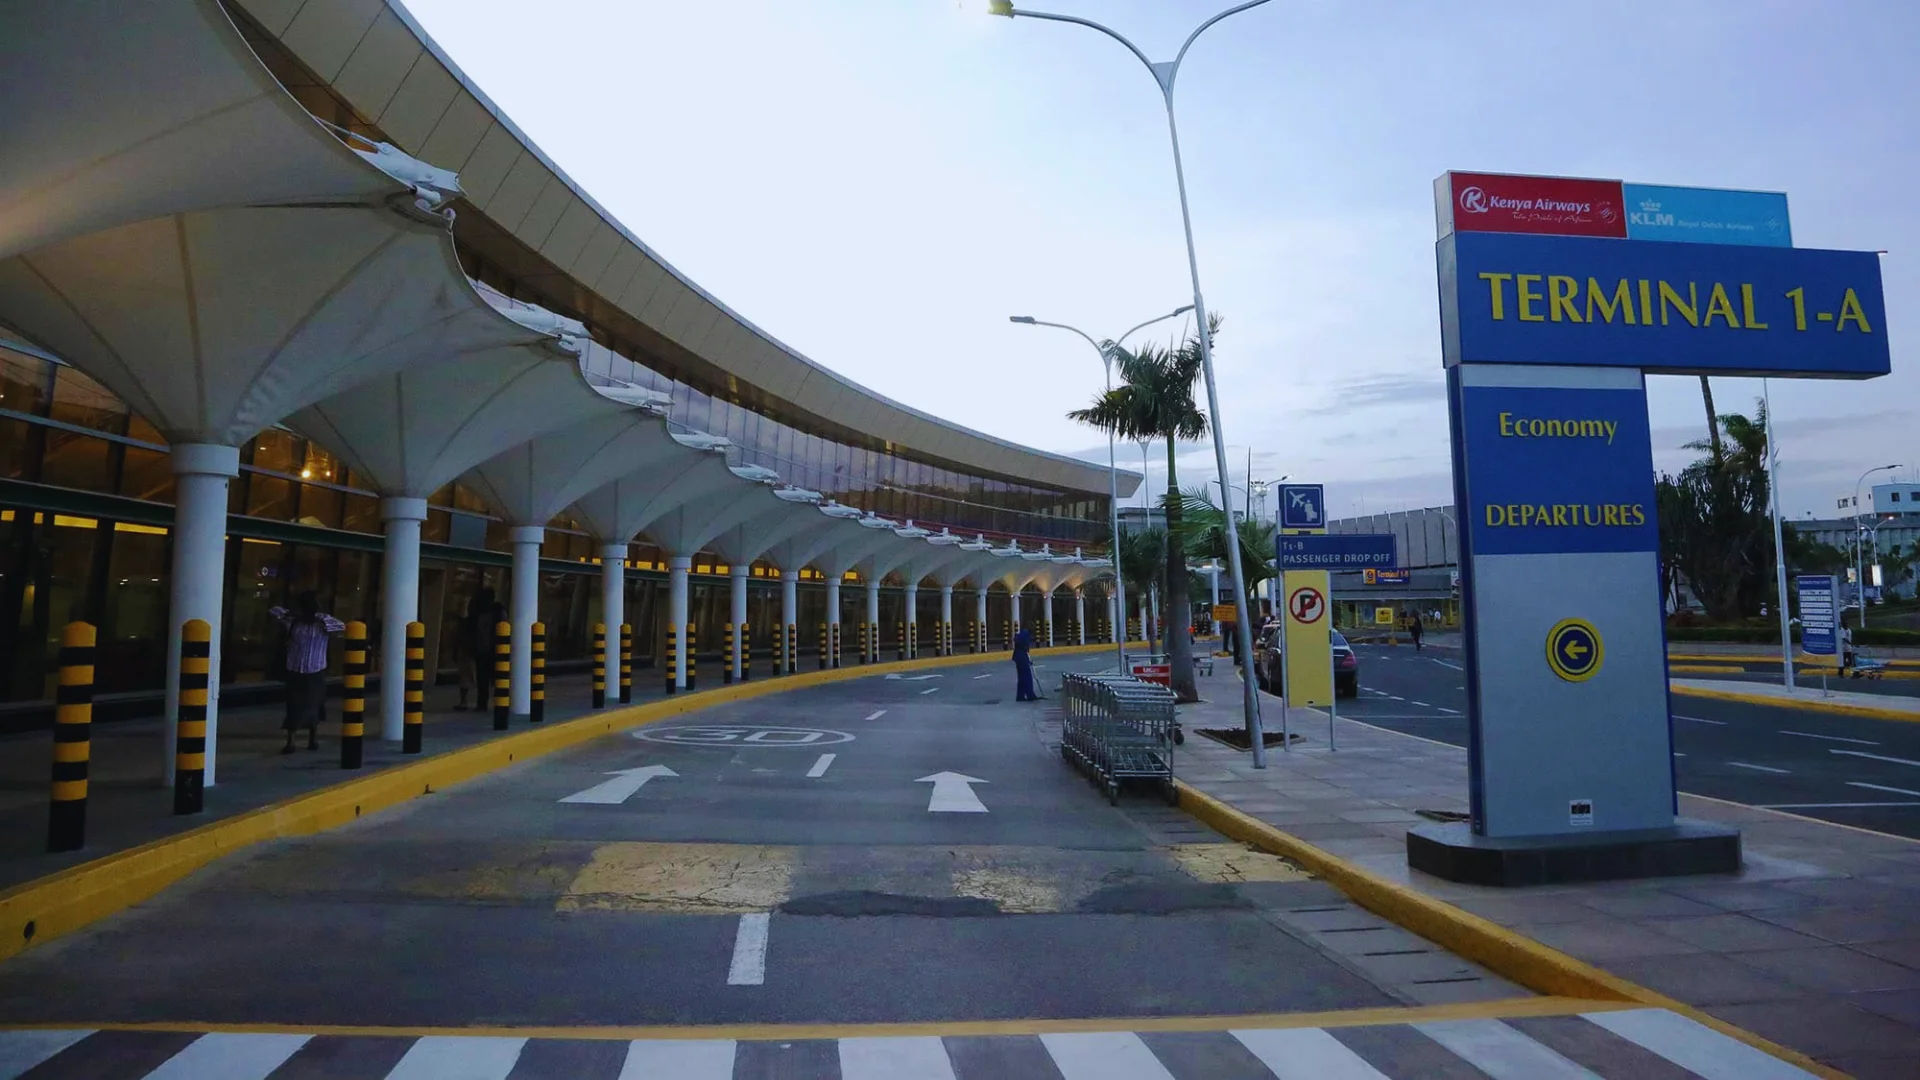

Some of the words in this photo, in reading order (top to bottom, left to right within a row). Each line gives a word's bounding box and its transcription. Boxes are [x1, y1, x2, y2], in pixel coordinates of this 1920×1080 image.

[1490, 195, 1532, 211] Kenya
[1534, 198, 1591, 217] Airways
[1630, 212, 1674, 226] KLM
[1478, 272, 1768, 330] TERMINAL
[1785, 285, 1873, 333] 1-A
[1499, 412, 1618, 445] Economy
[1485, 503, 1645, 527] DEPARTURES
[1283, 554, 1341, 563] PASSENGER
[1344, 553, 1371, 562] DROP
[1374, 553, 1391, 562] OFF
[664, 728, 823, 743] 30
